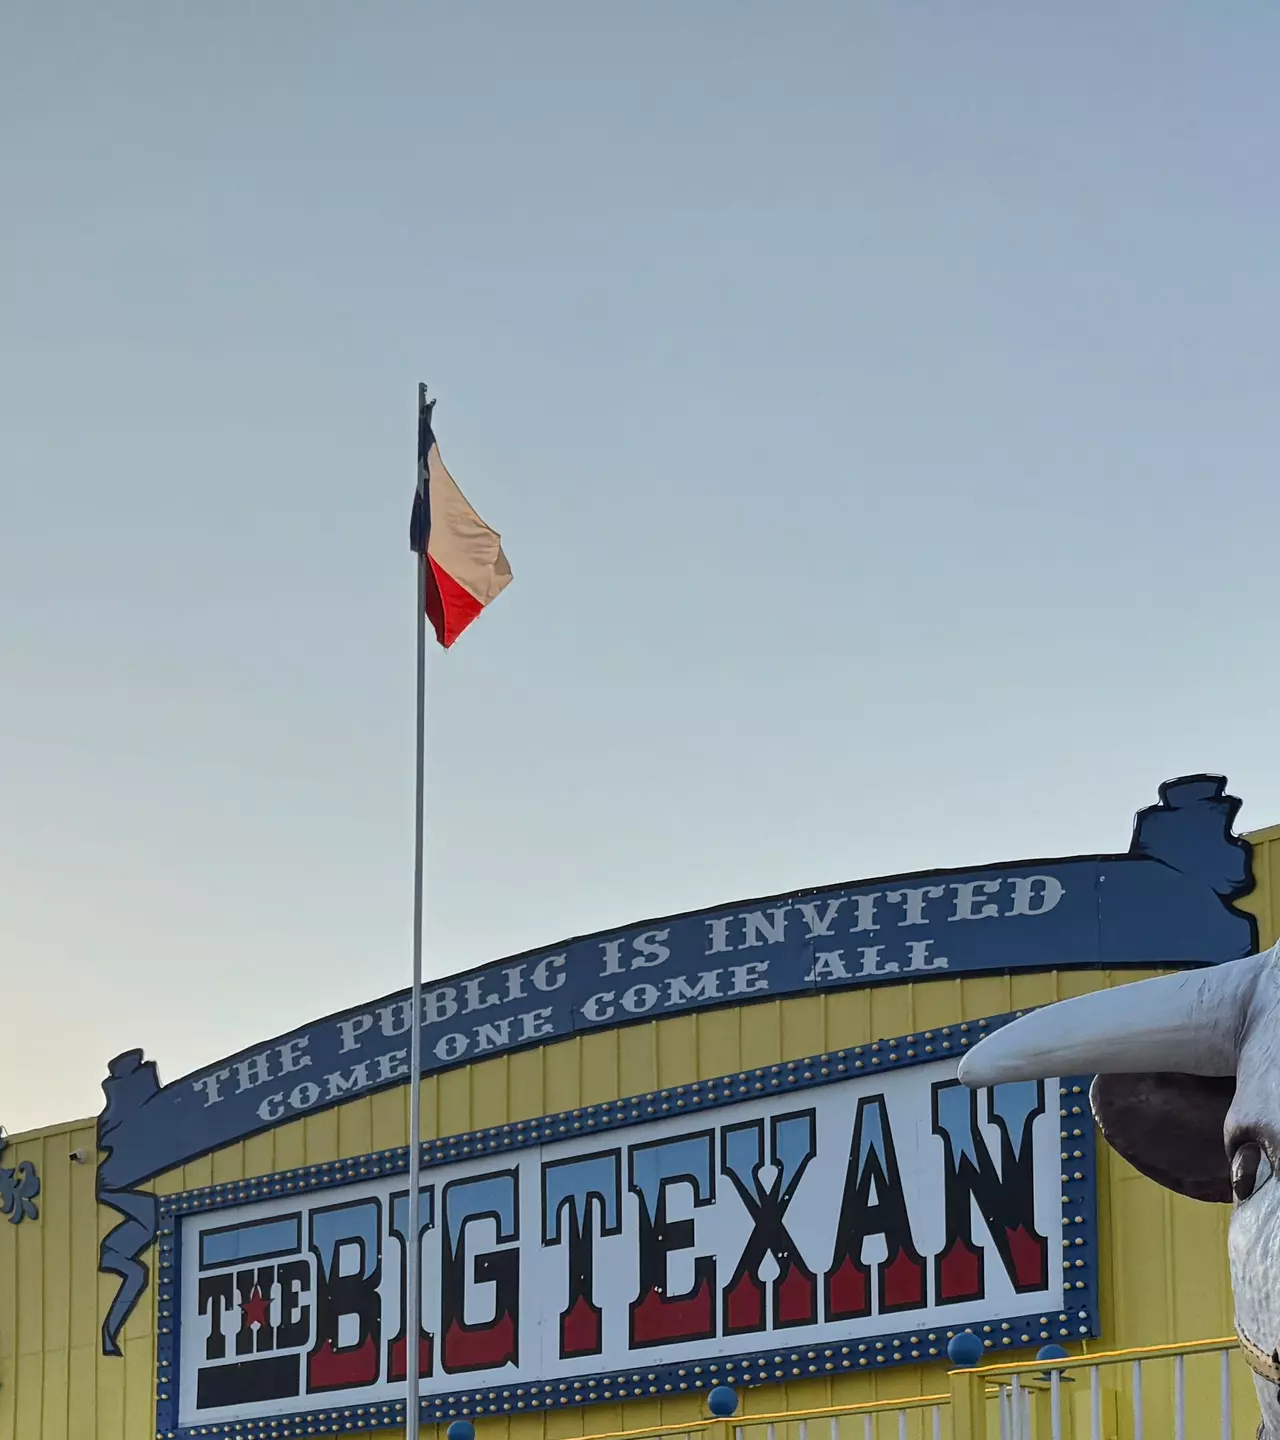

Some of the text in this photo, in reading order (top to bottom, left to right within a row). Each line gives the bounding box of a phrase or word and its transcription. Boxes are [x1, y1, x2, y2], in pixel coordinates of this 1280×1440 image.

[193, 875, 1066, 1107] THE PUBLIC IS INVITED
[256, 939, 949, 1121] COME ONE COME ALL
[198, 1078, 1048, 1395] THE BIG TEXAN
